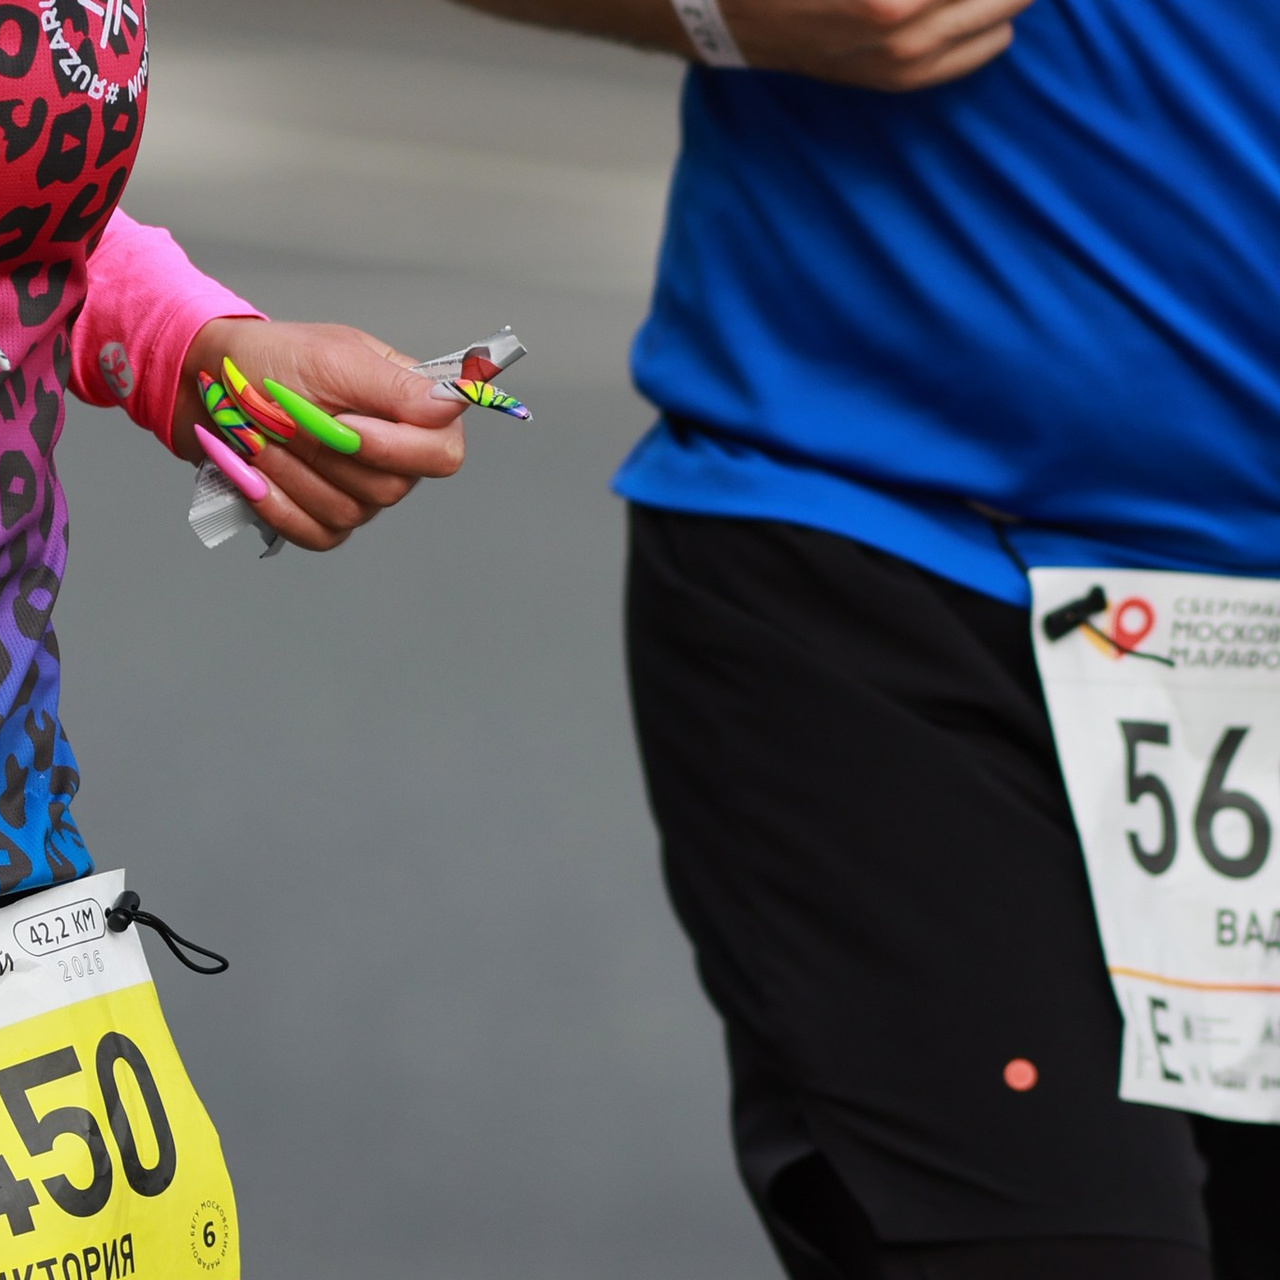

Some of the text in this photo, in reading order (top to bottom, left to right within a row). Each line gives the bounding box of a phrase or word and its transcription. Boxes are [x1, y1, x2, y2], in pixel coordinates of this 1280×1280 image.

[1117, 718, 1280, 878] 56
[29, 907, 96, 946] 42,2 КМ
[203, 1221, 216, 1248] 6
